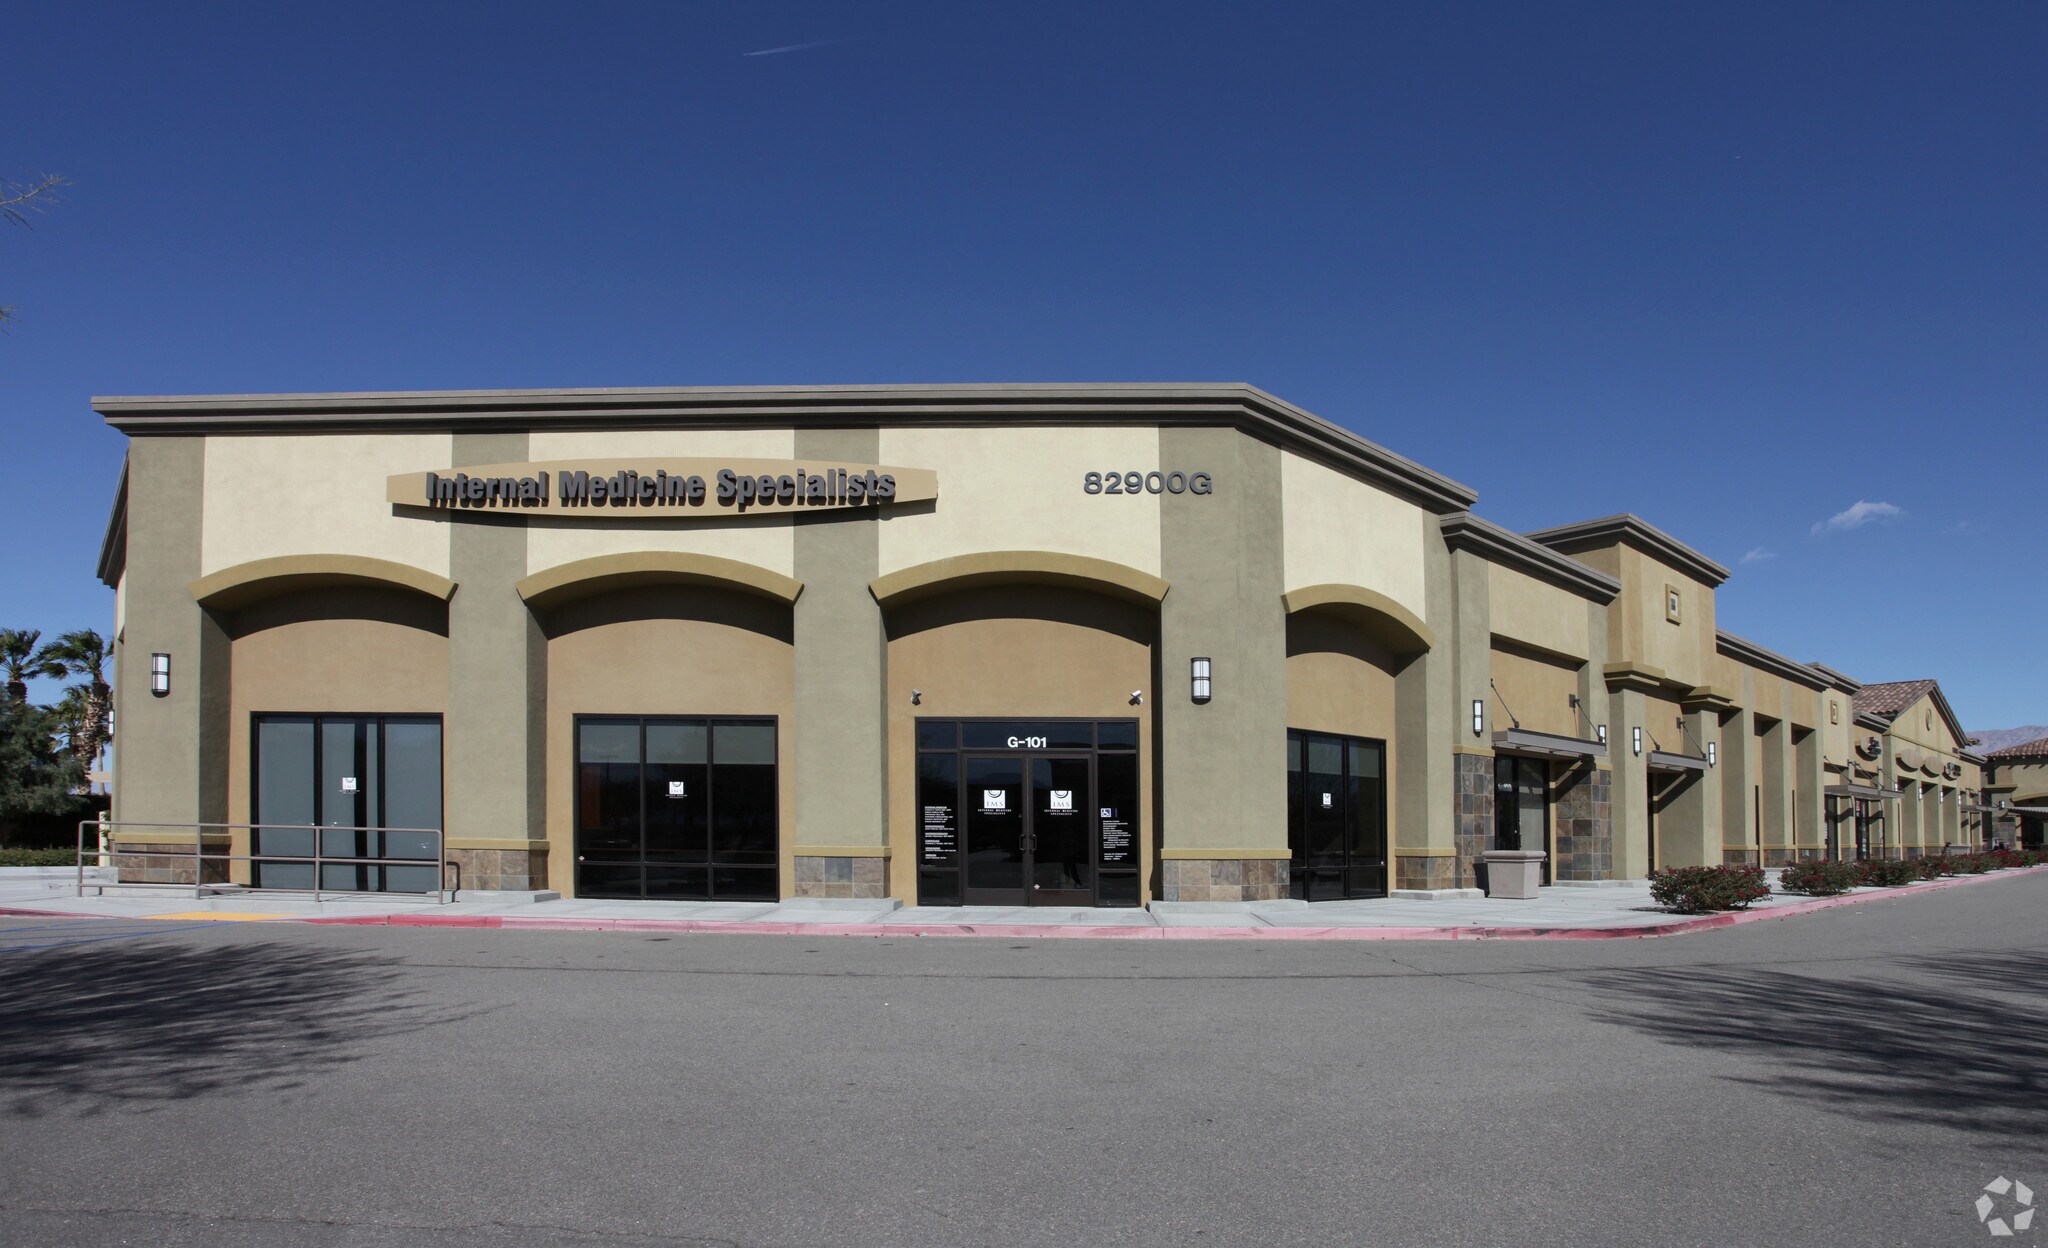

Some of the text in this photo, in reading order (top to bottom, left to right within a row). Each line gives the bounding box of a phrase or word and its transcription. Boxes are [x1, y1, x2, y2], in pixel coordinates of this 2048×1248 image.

[426, 468, 896, 504] Internal Medicine Specialists
[1083, 471, 1213, 495] 82900G
[1007, 736, 1047, 748] G-101
